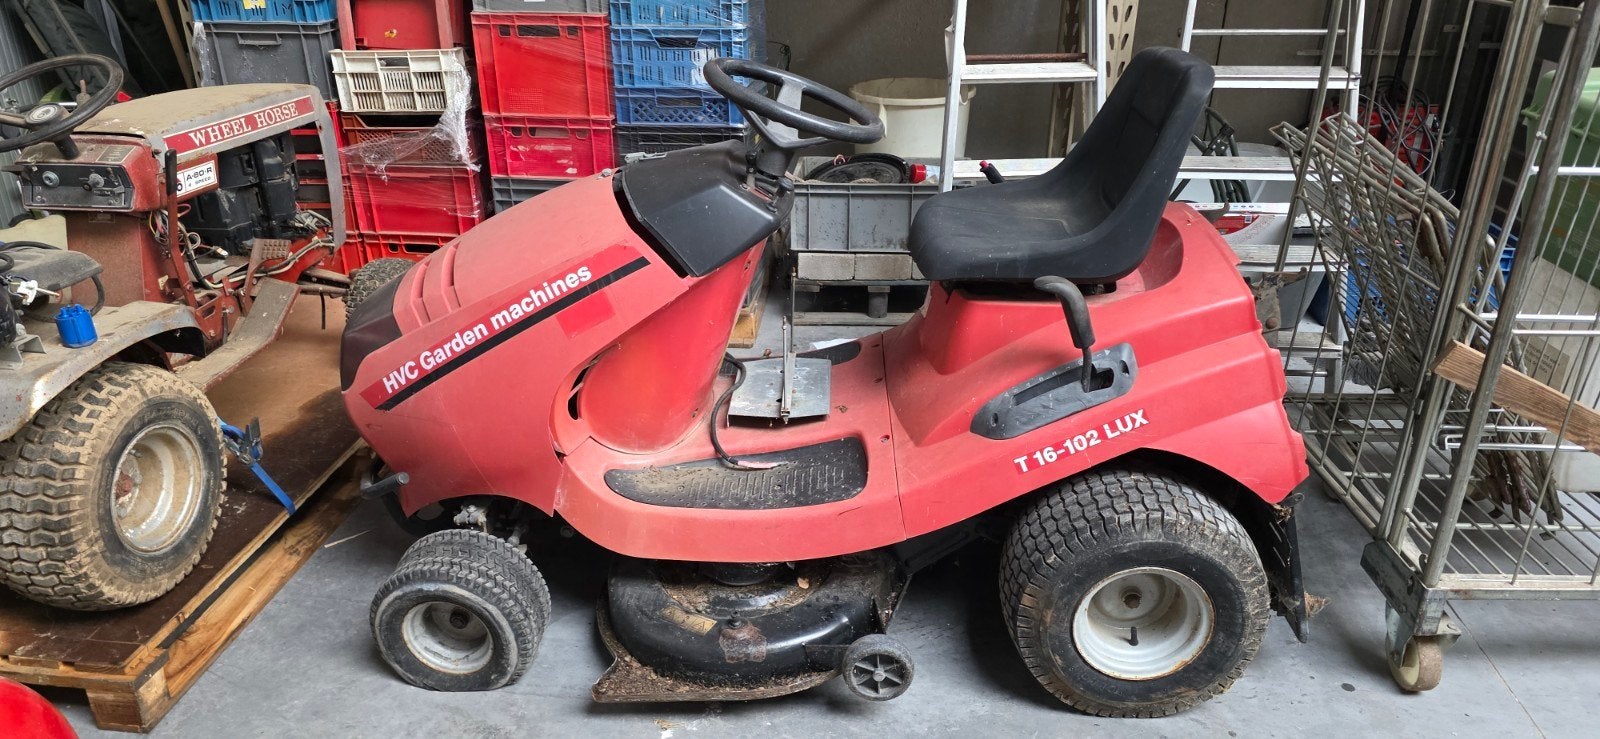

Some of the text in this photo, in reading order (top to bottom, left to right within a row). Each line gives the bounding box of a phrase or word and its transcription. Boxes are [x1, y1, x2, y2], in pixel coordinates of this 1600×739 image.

[188, 102, 299, 147] WHEEL HORSE
[382, 266, 592, 394] HVC Garden machines
[1013, 408, 1149, 473] T 16-102 LUX
